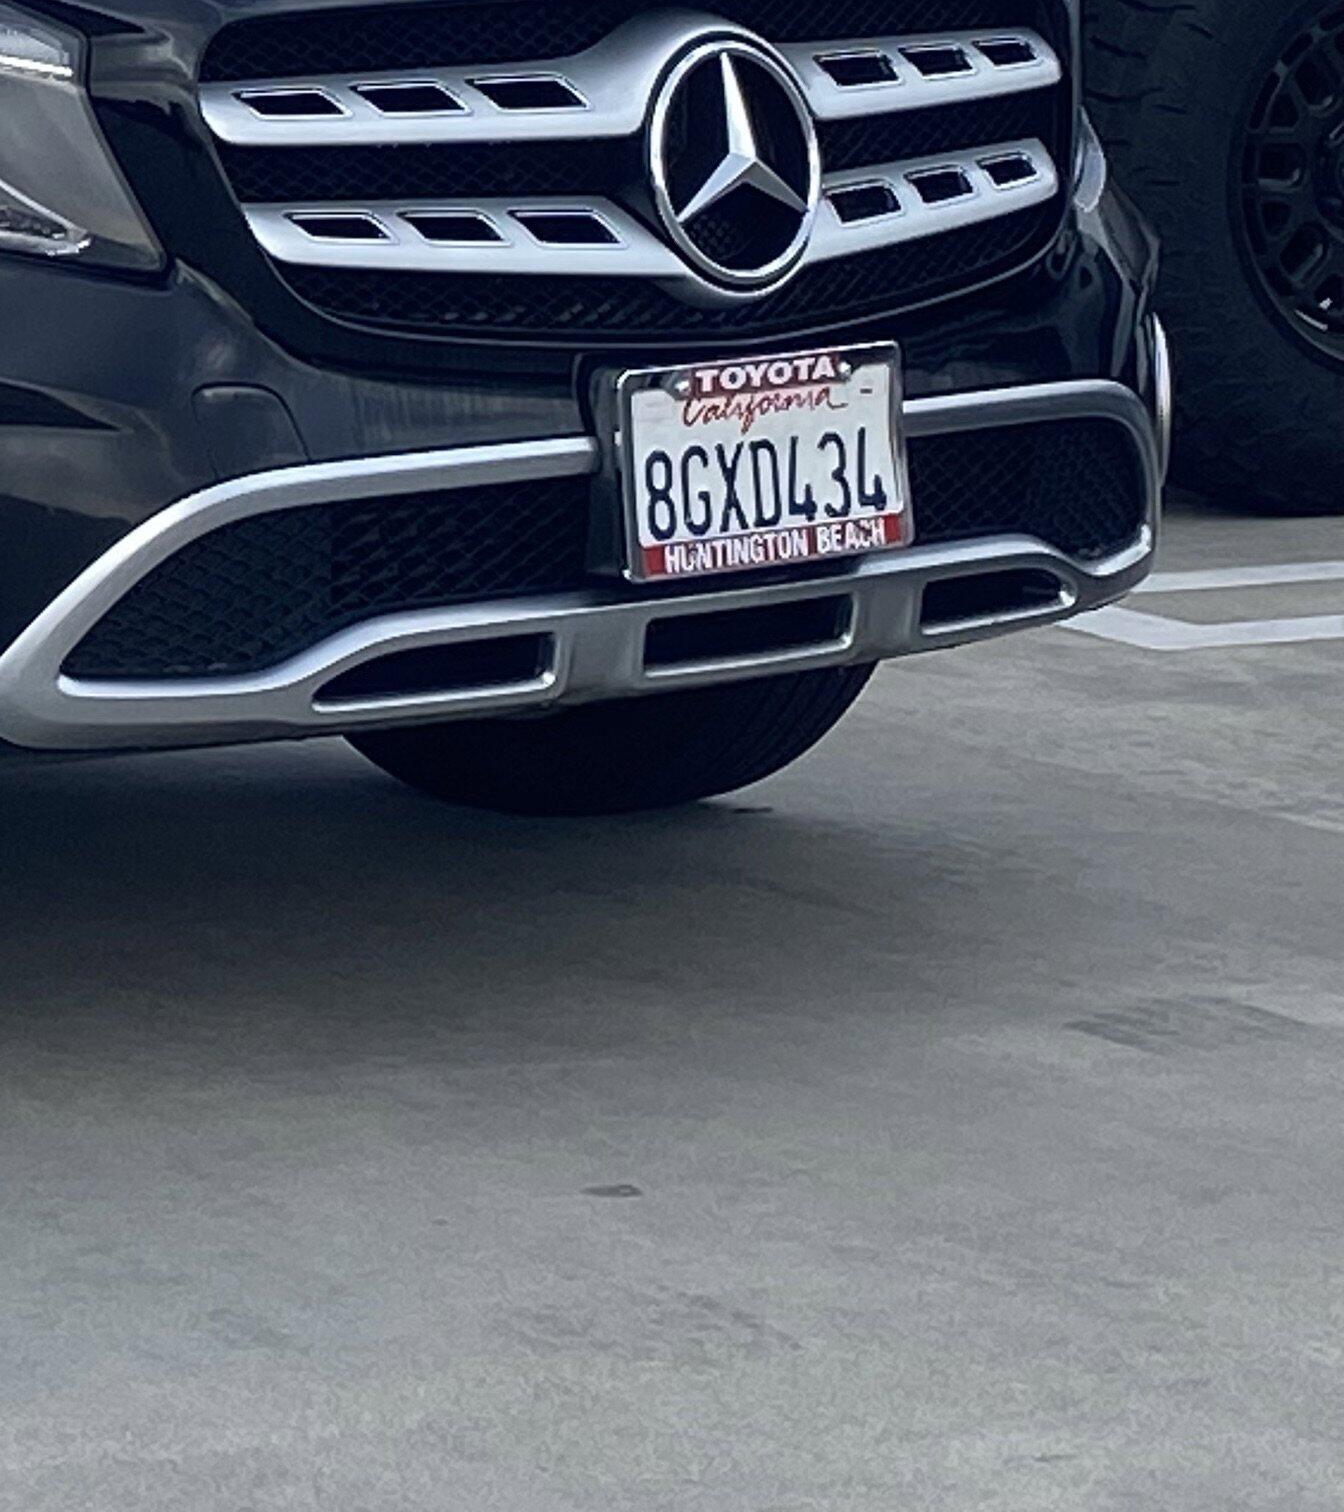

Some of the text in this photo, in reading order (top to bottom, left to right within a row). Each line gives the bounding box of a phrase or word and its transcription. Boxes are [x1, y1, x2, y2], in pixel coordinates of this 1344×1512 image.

[694, 354, 836, 393] TOYOTA
[682, 385, 849, 435] California
[644, 426, 888, 541] 8GXD434
[663, 517, 886, 574] HUNTINGTON BEACH
